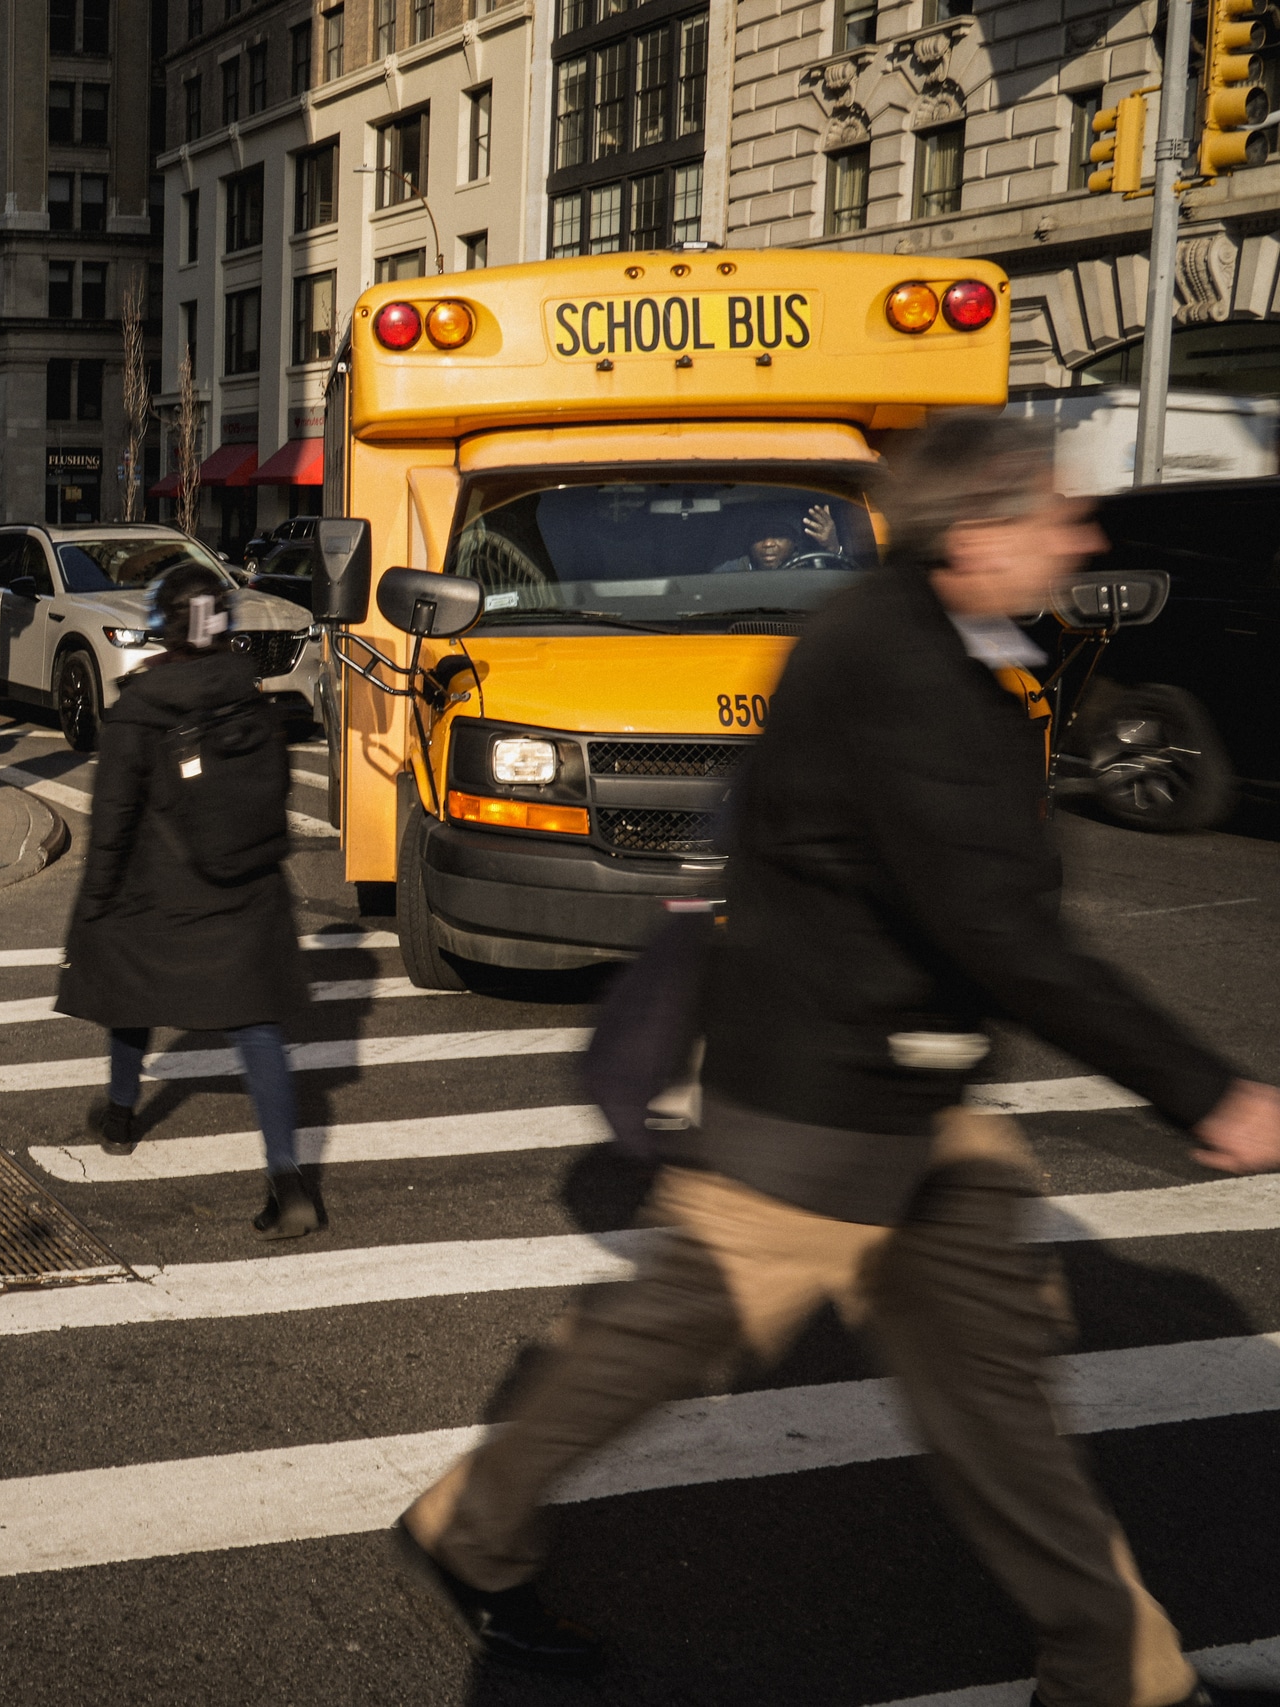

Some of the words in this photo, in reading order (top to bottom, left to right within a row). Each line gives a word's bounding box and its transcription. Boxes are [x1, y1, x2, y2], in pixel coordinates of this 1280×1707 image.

[555, 297, 715, 357] SCHOOL
[728, 293, 811, 350] BUS
[48, 455, 100, 465] FLUSHING
[717, 694, 776, 727] 850
